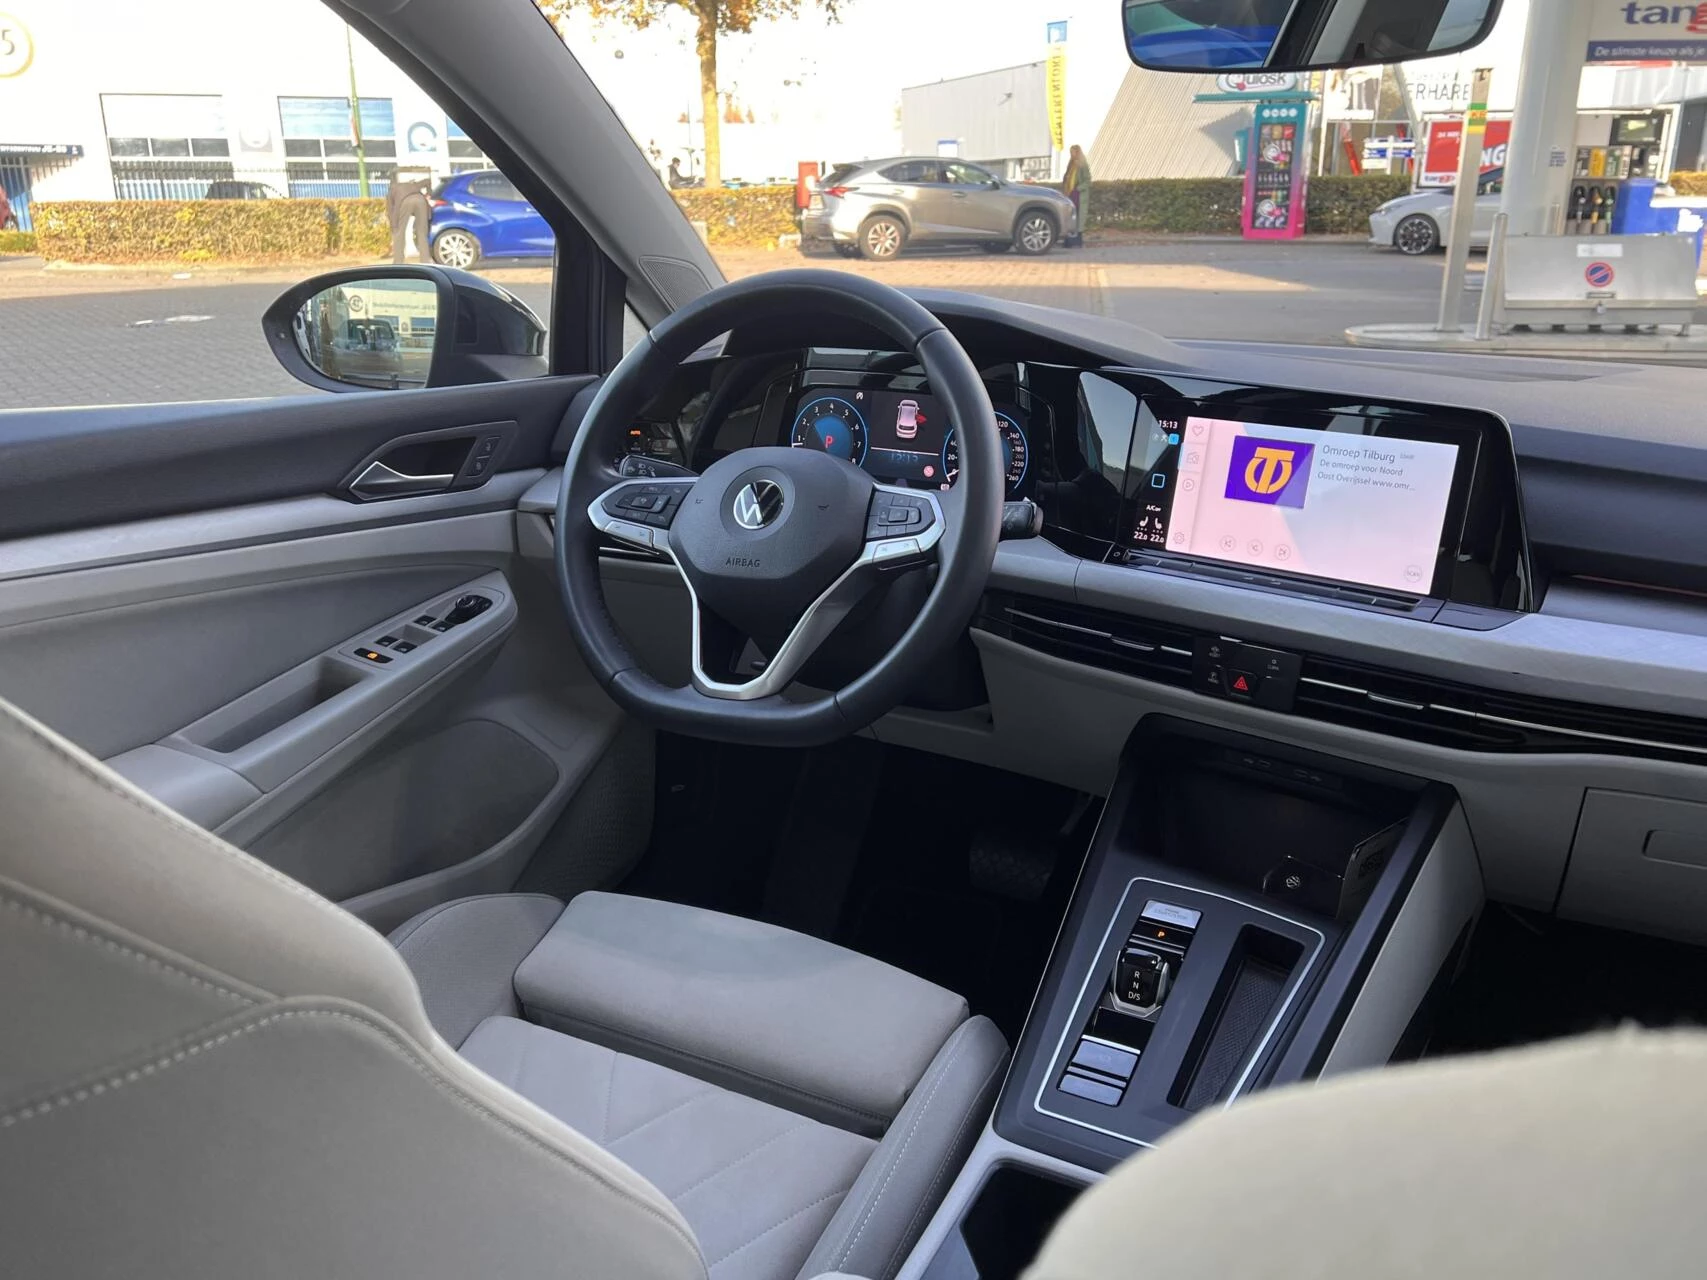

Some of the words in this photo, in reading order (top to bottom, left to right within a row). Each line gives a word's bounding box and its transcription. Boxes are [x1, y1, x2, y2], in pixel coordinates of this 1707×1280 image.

[1159, 419, 1178, 429] 15:13
[825, 435, 833, 449] P
[1322, 444, 1361, 459] Omroep
[1363, 449, 1396, 464] Tilburg
[1320, 459, 1330, 468] De
[1331, 461, 1360, 472] omroep
[1361, 465, 1378, 473] voor
[1379, 466, 1403, 477] Noord
[1317, 471, 1335, 480] Oost
[1336, 473, 1371, 485] Overijssel
[725, 556, 760, 568] AIRBAG
[1134, 971, 1140, 979] R
[1133, 982, 1139, 990] N
[1128, 991, 1140, 1001] D/S
